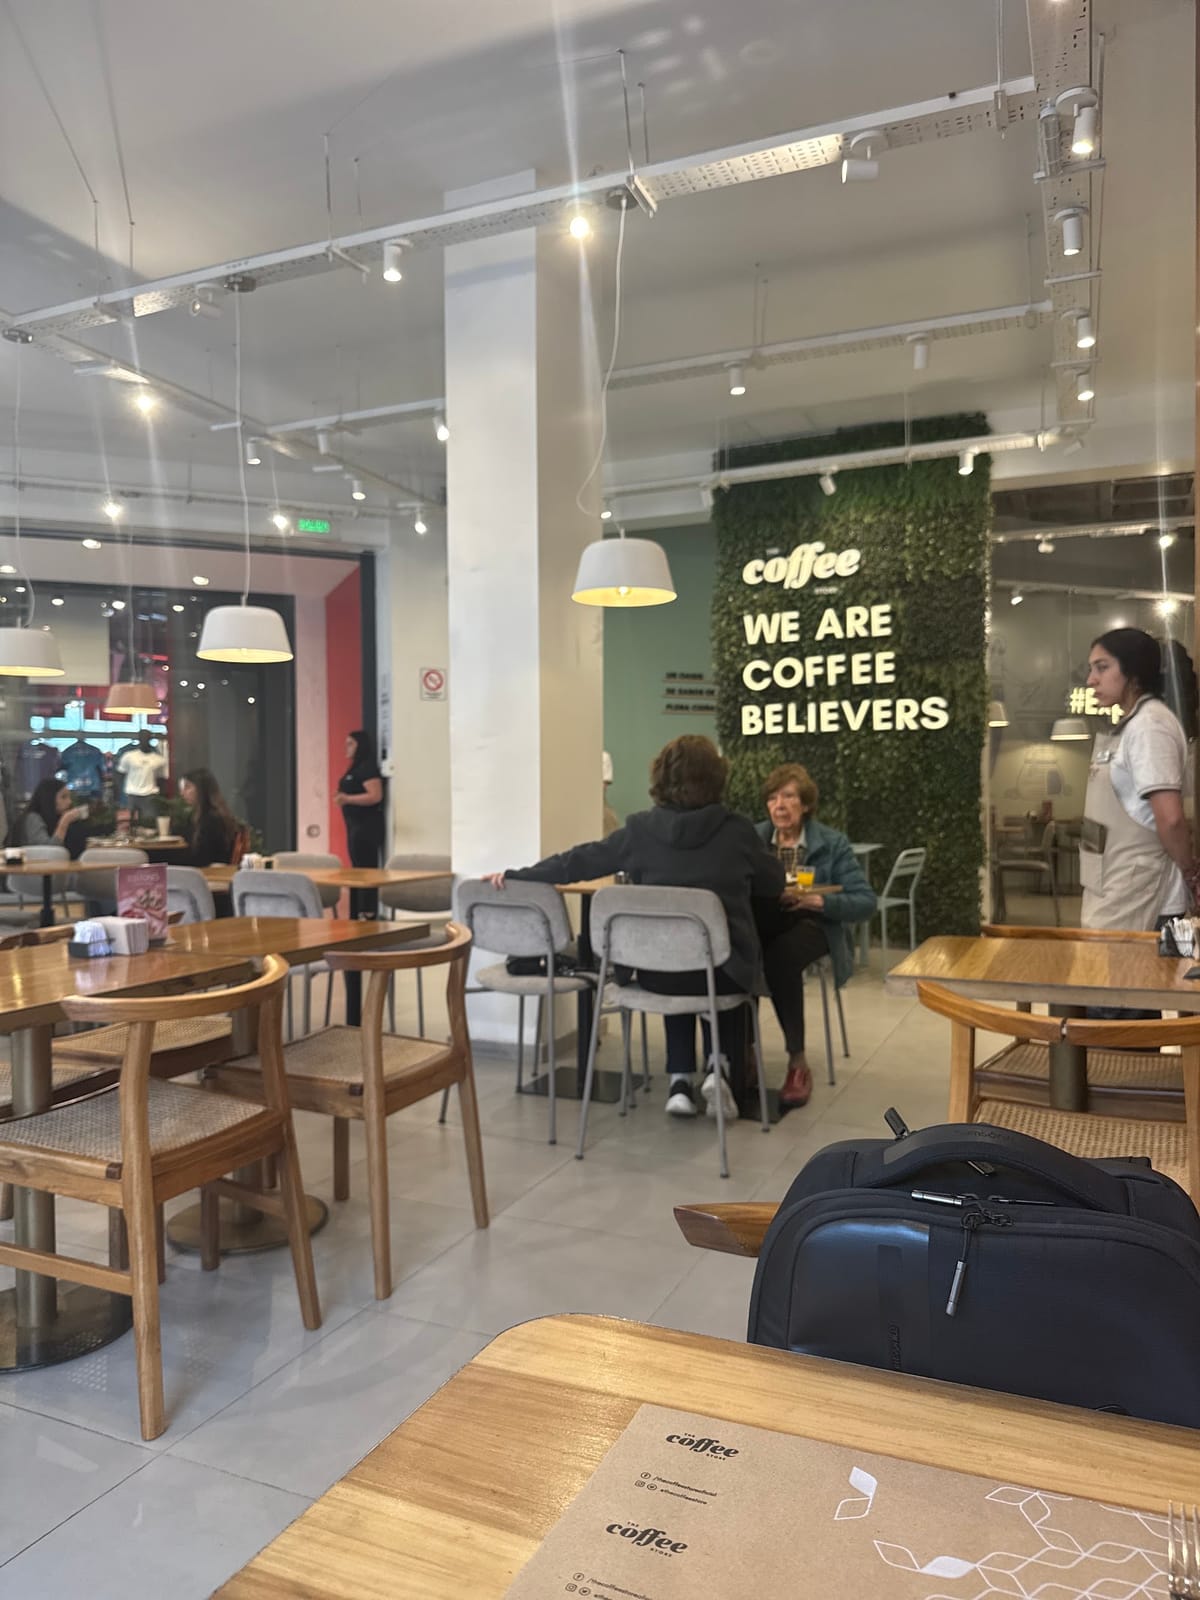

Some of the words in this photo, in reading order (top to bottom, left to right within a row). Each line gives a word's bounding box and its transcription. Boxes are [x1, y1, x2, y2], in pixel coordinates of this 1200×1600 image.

[742, 541, 860, 589] coffee
[743, 610, 800, 645] WE
[815, 604, 892, 641] ARE
[742, 651, 896, 691] COFFEE
[741, 696, 949, 735] BELIEVERS
[666, 1434, 739, 1458] coffee
[606, 1524, 688, 1554] coffee
